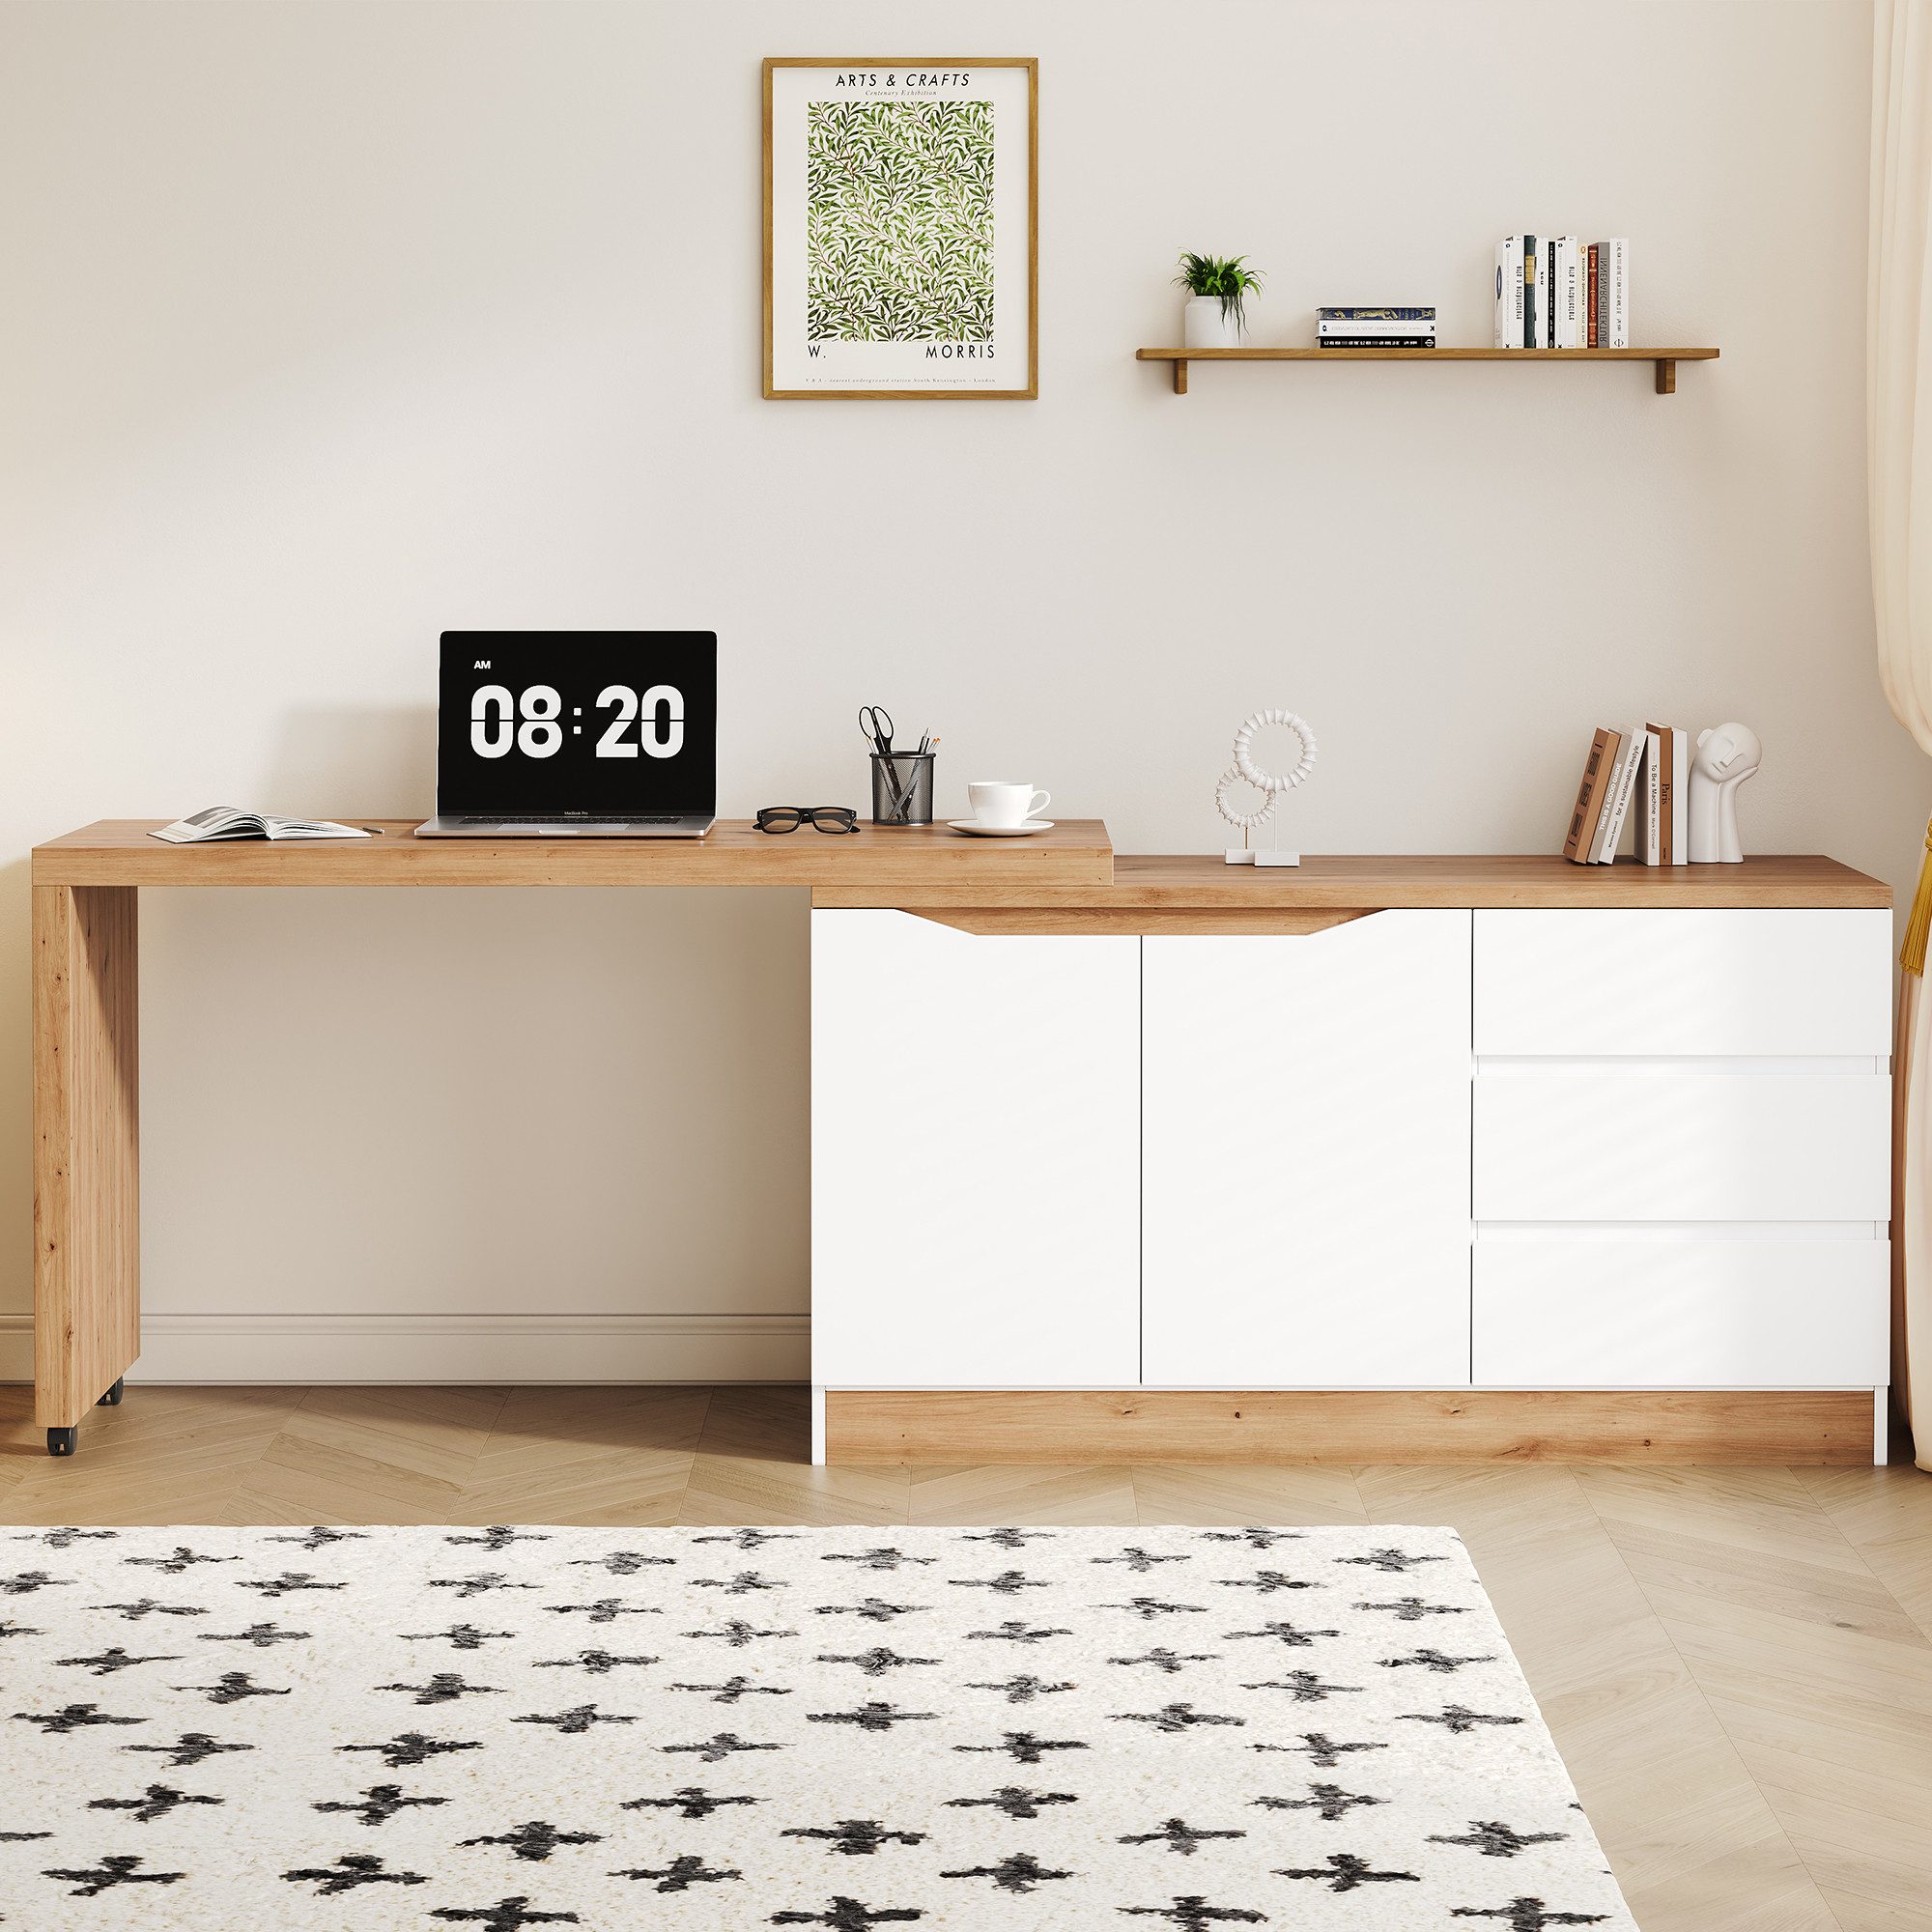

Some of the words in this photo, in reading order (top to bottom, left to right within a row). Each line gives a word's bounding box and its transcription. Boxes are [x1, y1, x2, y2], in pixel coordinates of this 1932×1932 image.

[836, 73, 877, 87] ARTS
[886, 73, 896, 87] &
[906, 73, 970, 87] CRAFTS
[808, 345, 826, 357] W.
[925, 345, 995, 358] MORRIS
[473, 660, 491, 669] AM
[1613, 763, 1622, 782] GUIDE
[1621, 768, 1633, 801] sustainable
[1629, 745, 1639, 767] lifestyle
[1662, 783, 1670, 805] Paris
